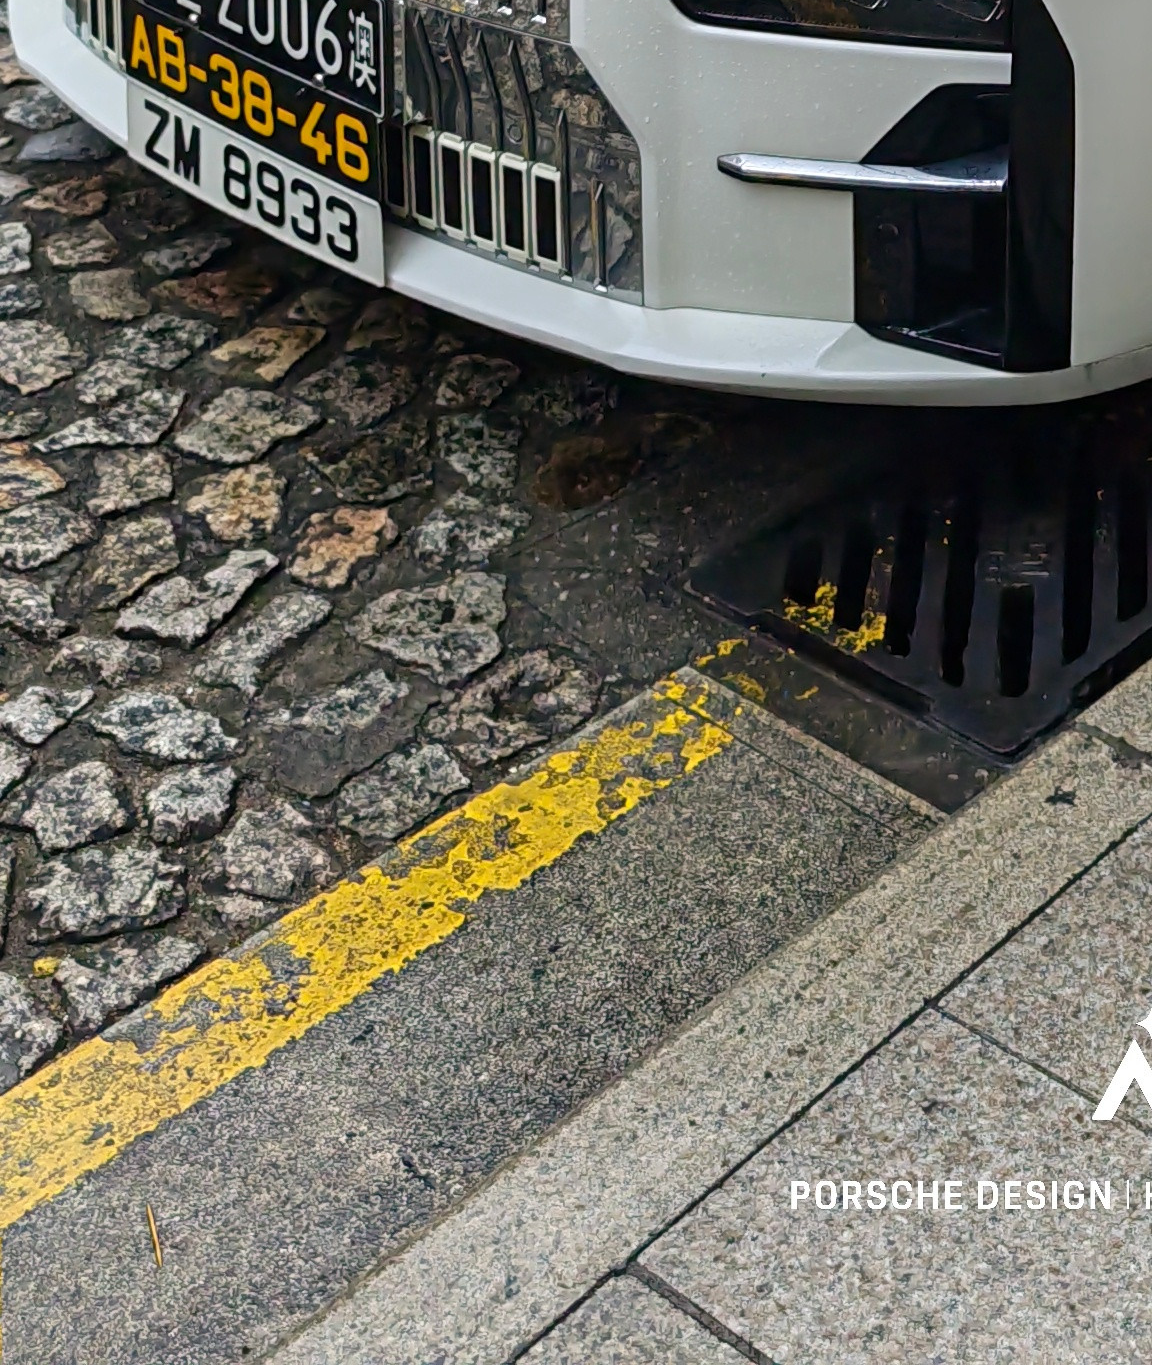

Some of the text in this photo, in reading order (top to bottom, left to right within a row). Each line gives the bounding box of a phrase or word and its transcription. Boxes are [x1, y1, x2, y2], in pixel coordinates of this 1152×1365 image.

[130, 13, 370, 183] AB-38-46
[143, 99, 359, 264] ZM 8933
